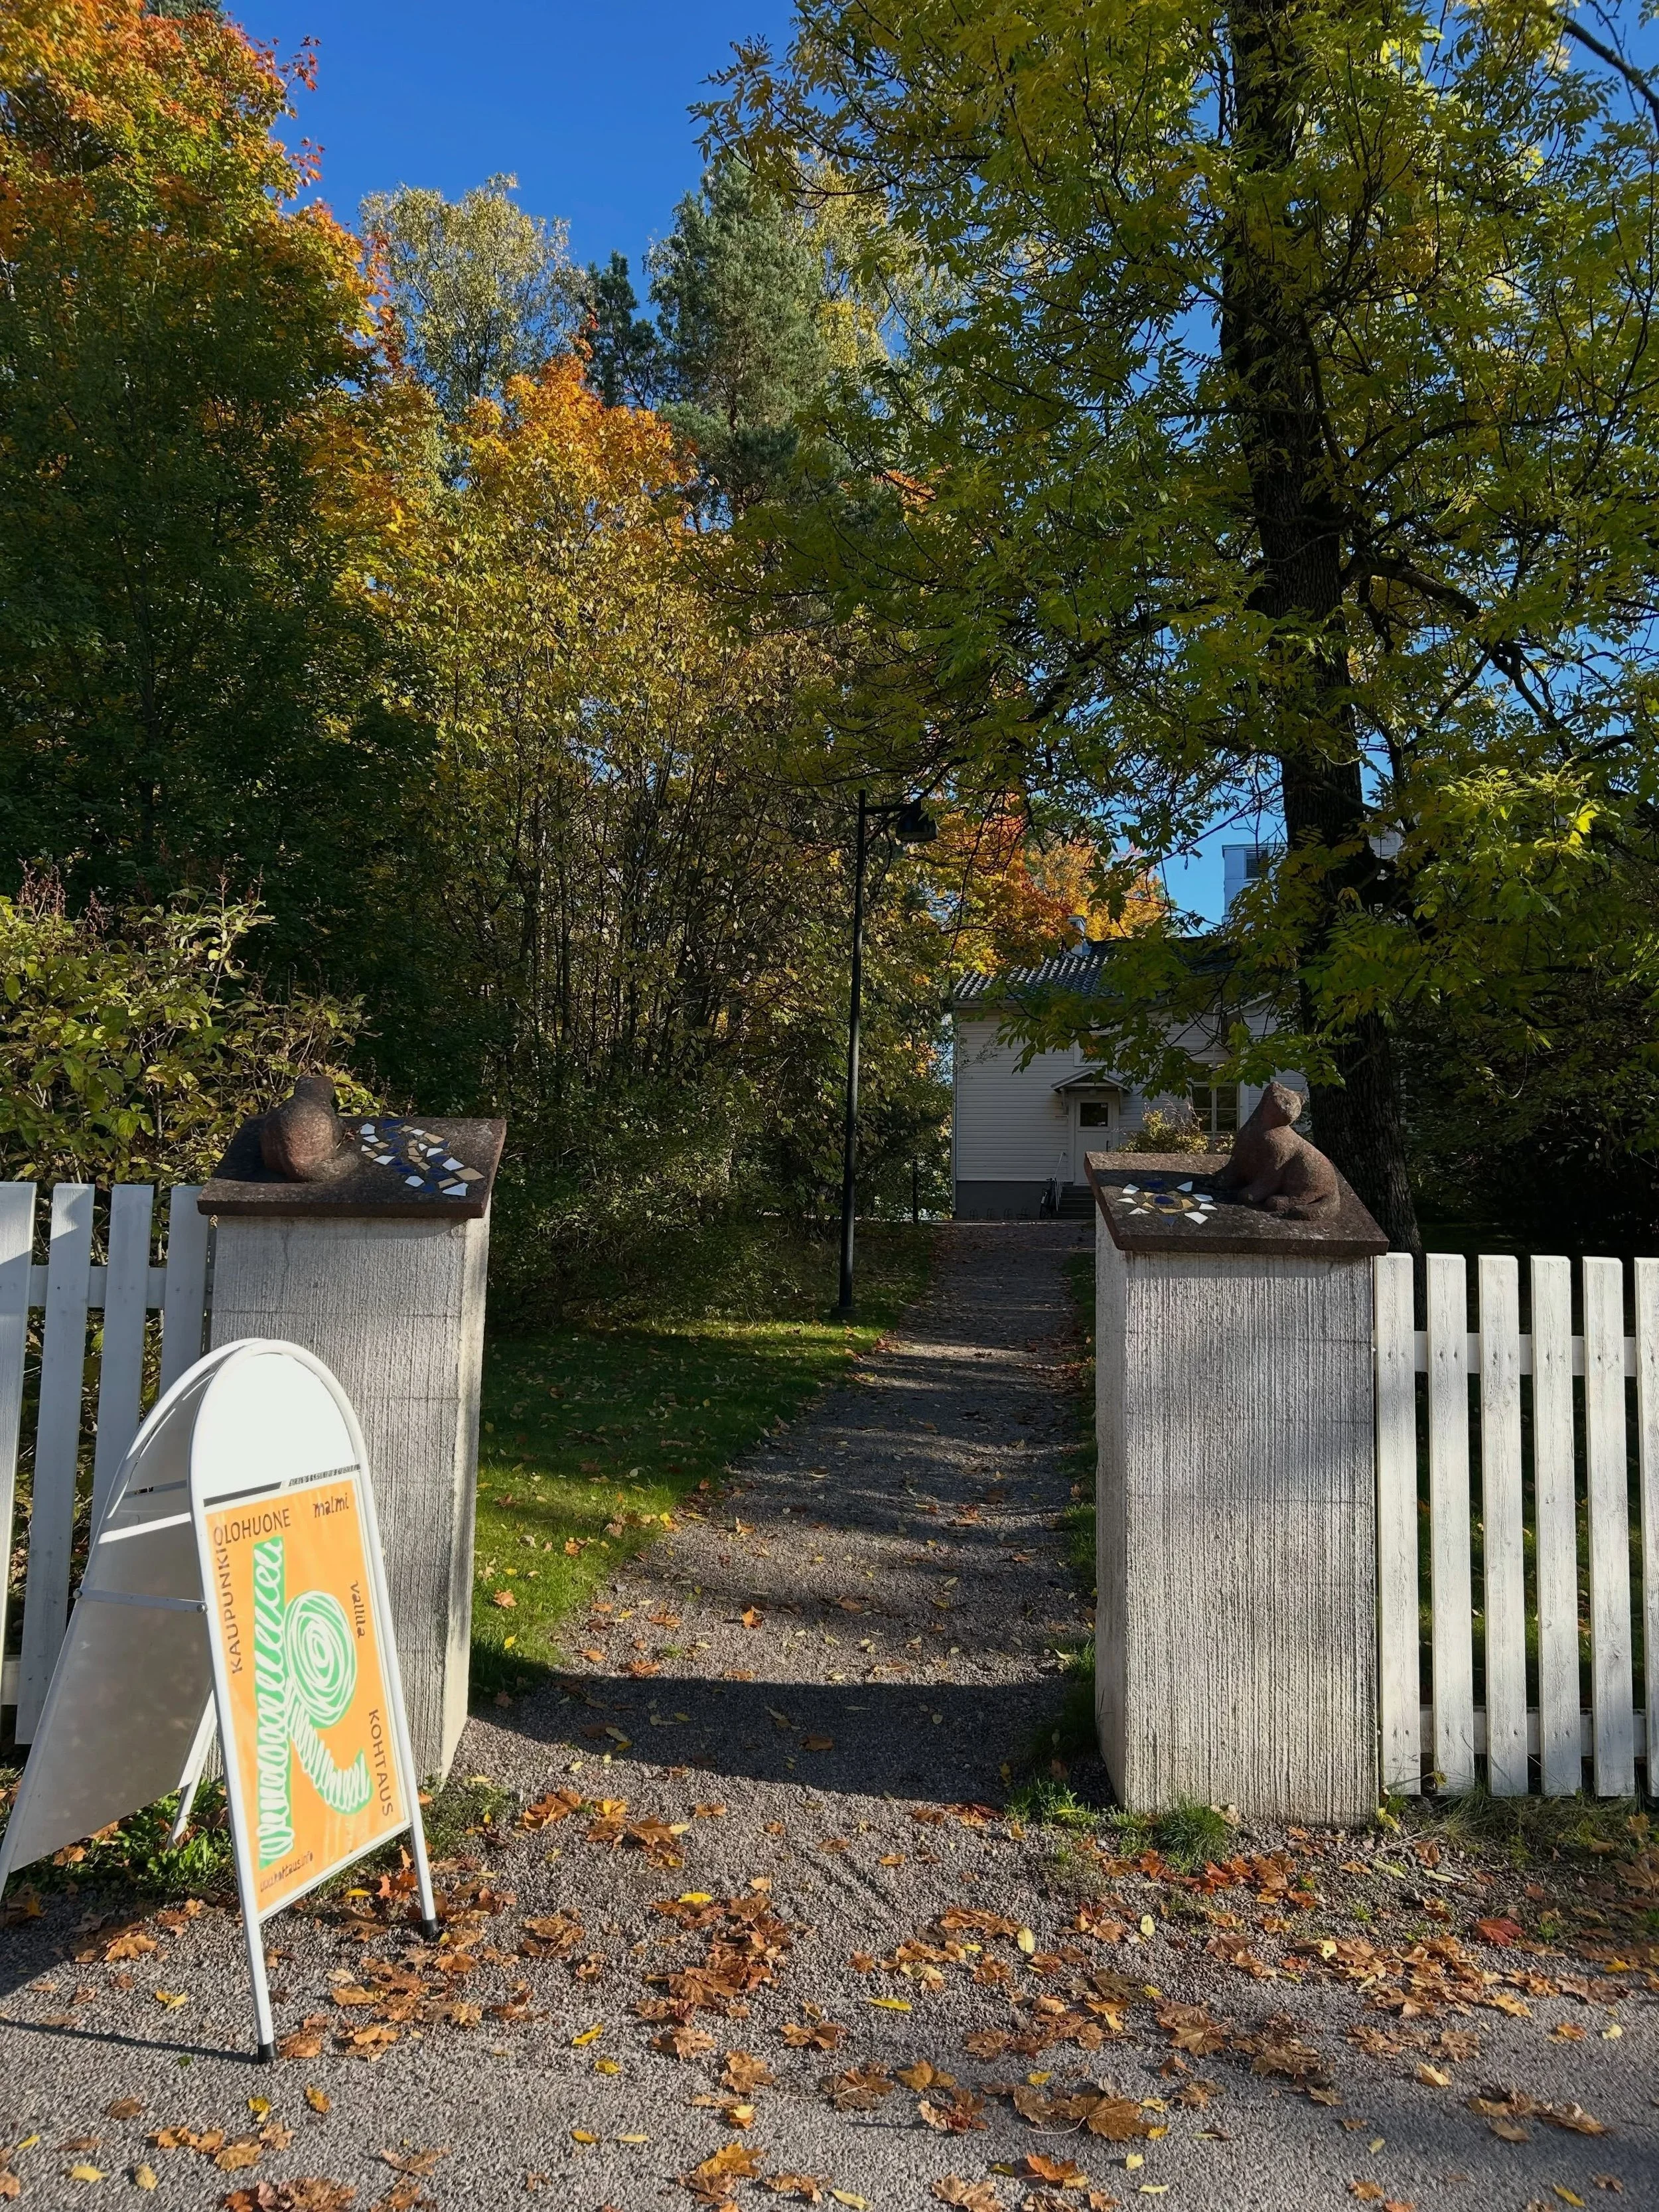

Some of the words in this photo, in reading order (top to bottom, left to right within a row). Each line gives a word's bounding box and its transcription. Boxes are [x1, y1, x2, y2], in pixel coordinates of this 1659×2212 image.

[313, 1493, 349, 1518] malmi
[350, 1580, 366, 1639] vallila
[369, 1709, 394, 1816] KOHTAUS
